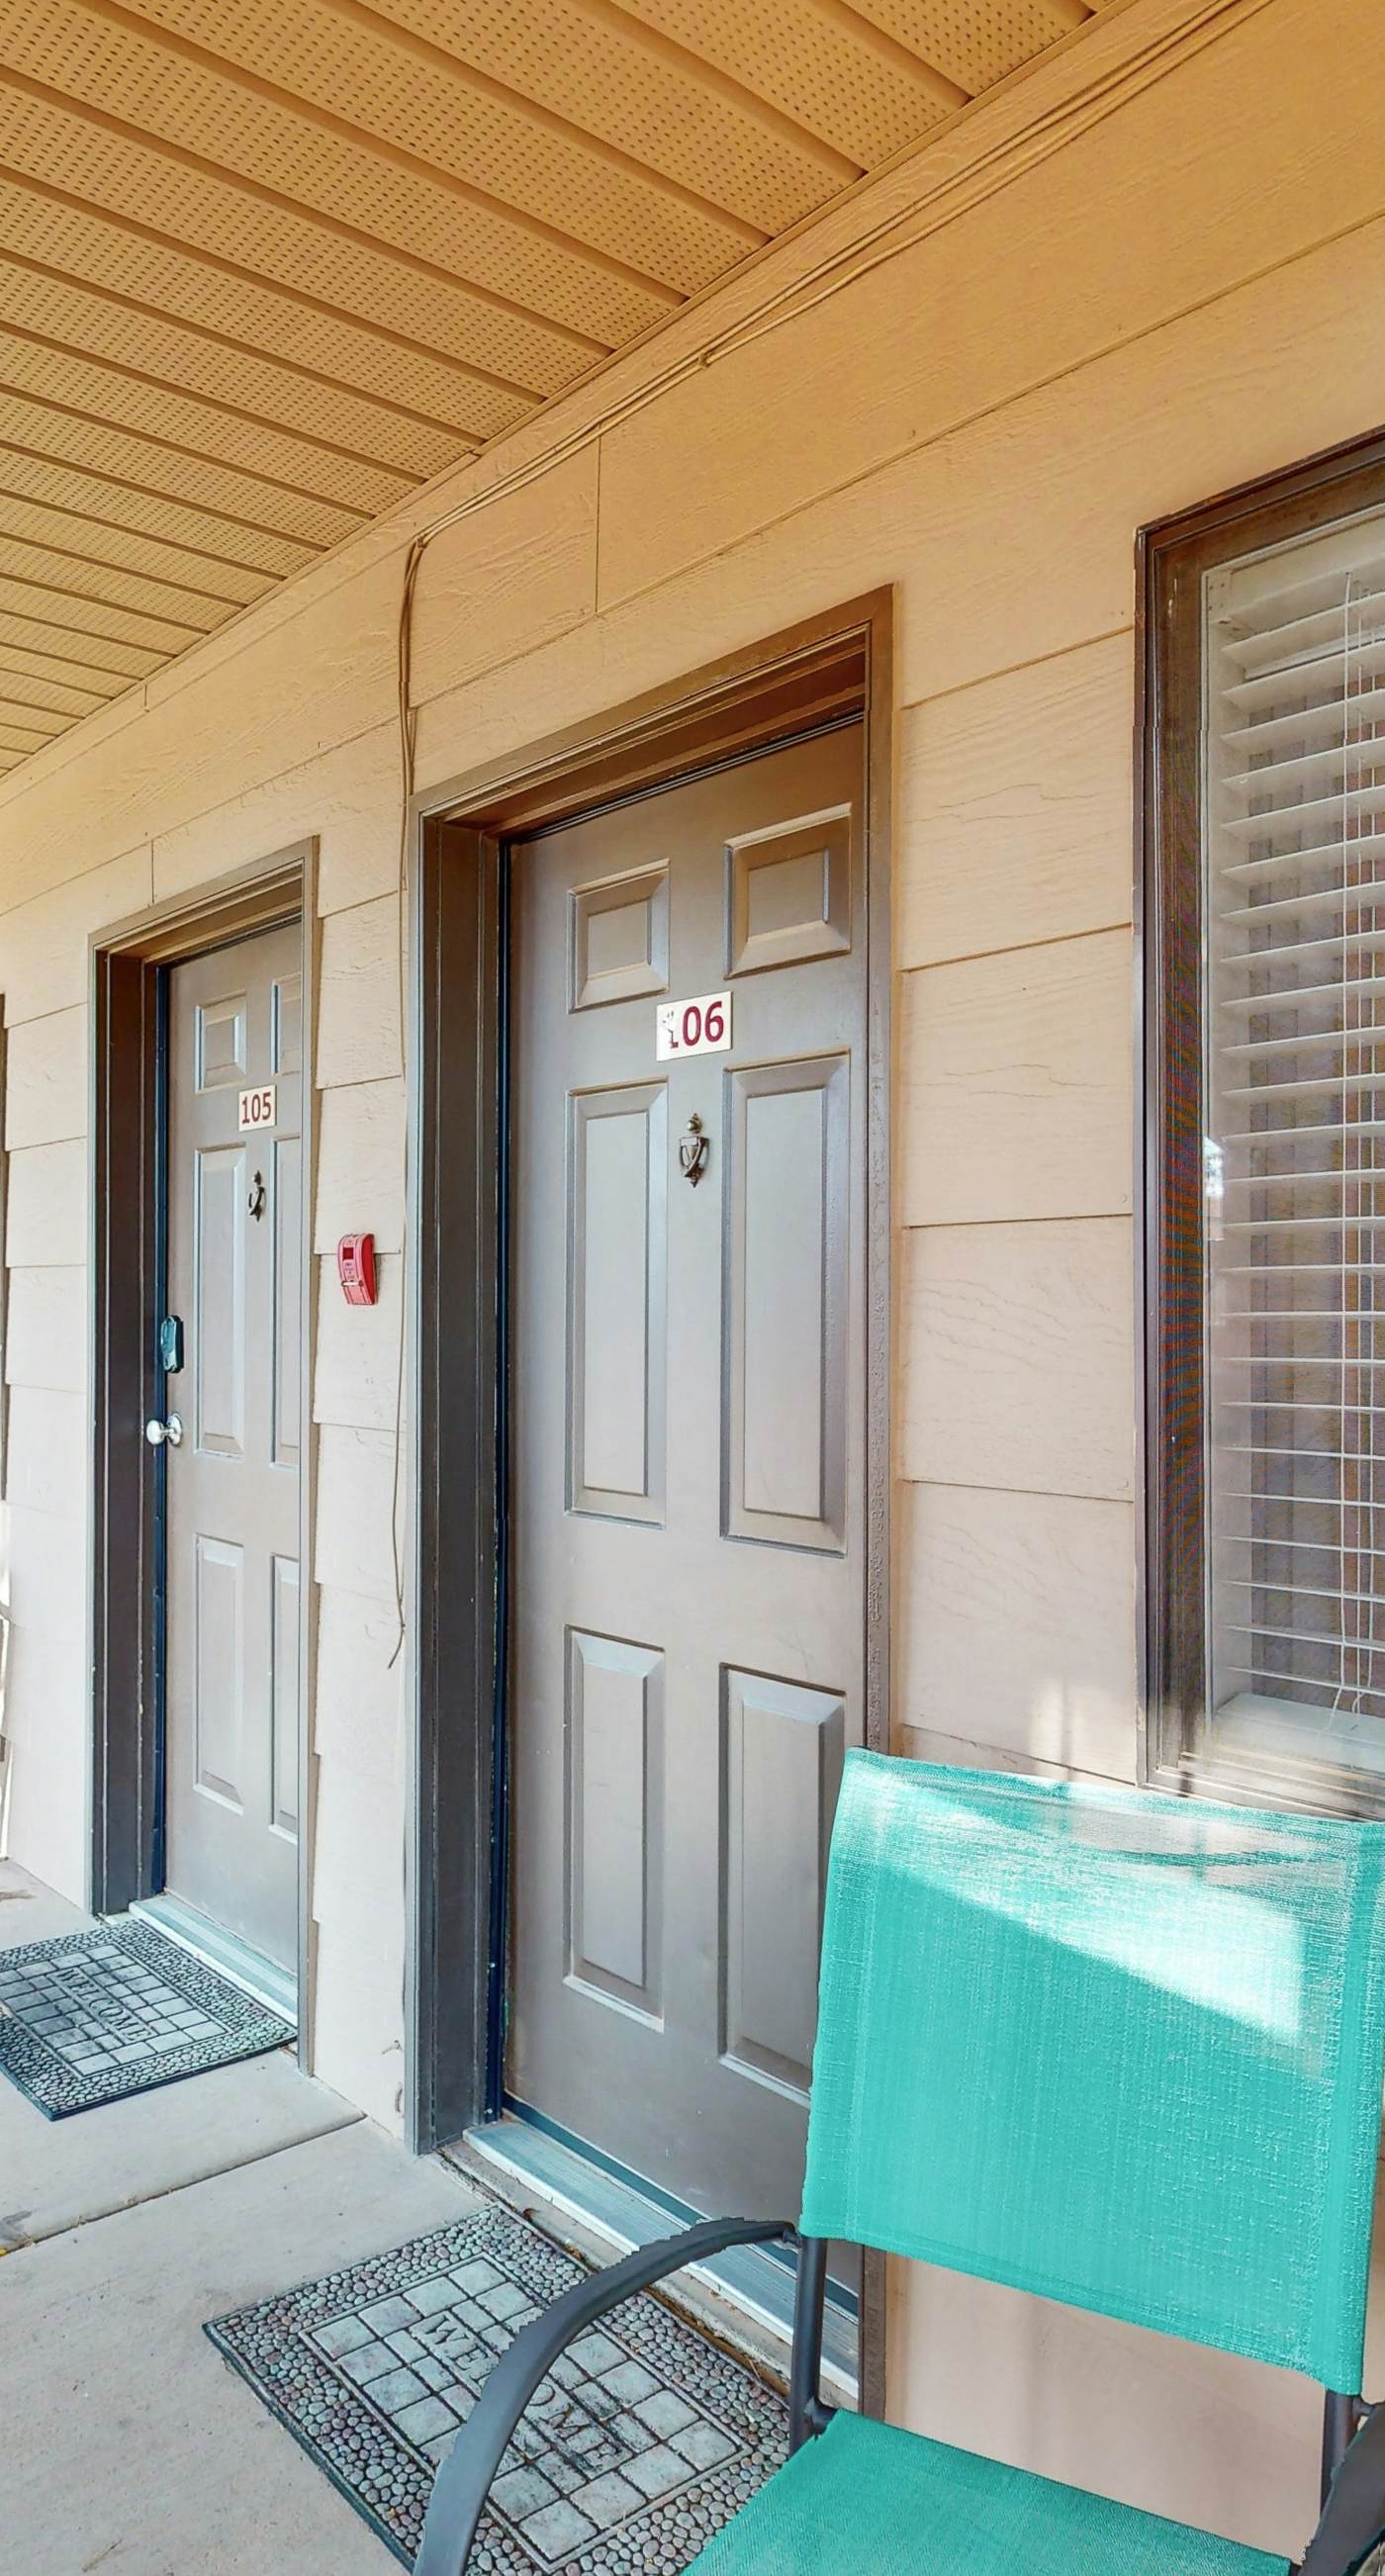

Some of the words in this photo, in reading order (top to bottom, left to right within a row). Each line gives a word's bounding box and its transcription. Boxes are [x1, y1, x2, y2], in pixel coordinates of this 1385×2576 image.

[242, 1092, 271, 1124] 105
[56, 1969, 151, 2041] WELCOME
[424, 2315, 620, 2470] WEOME
